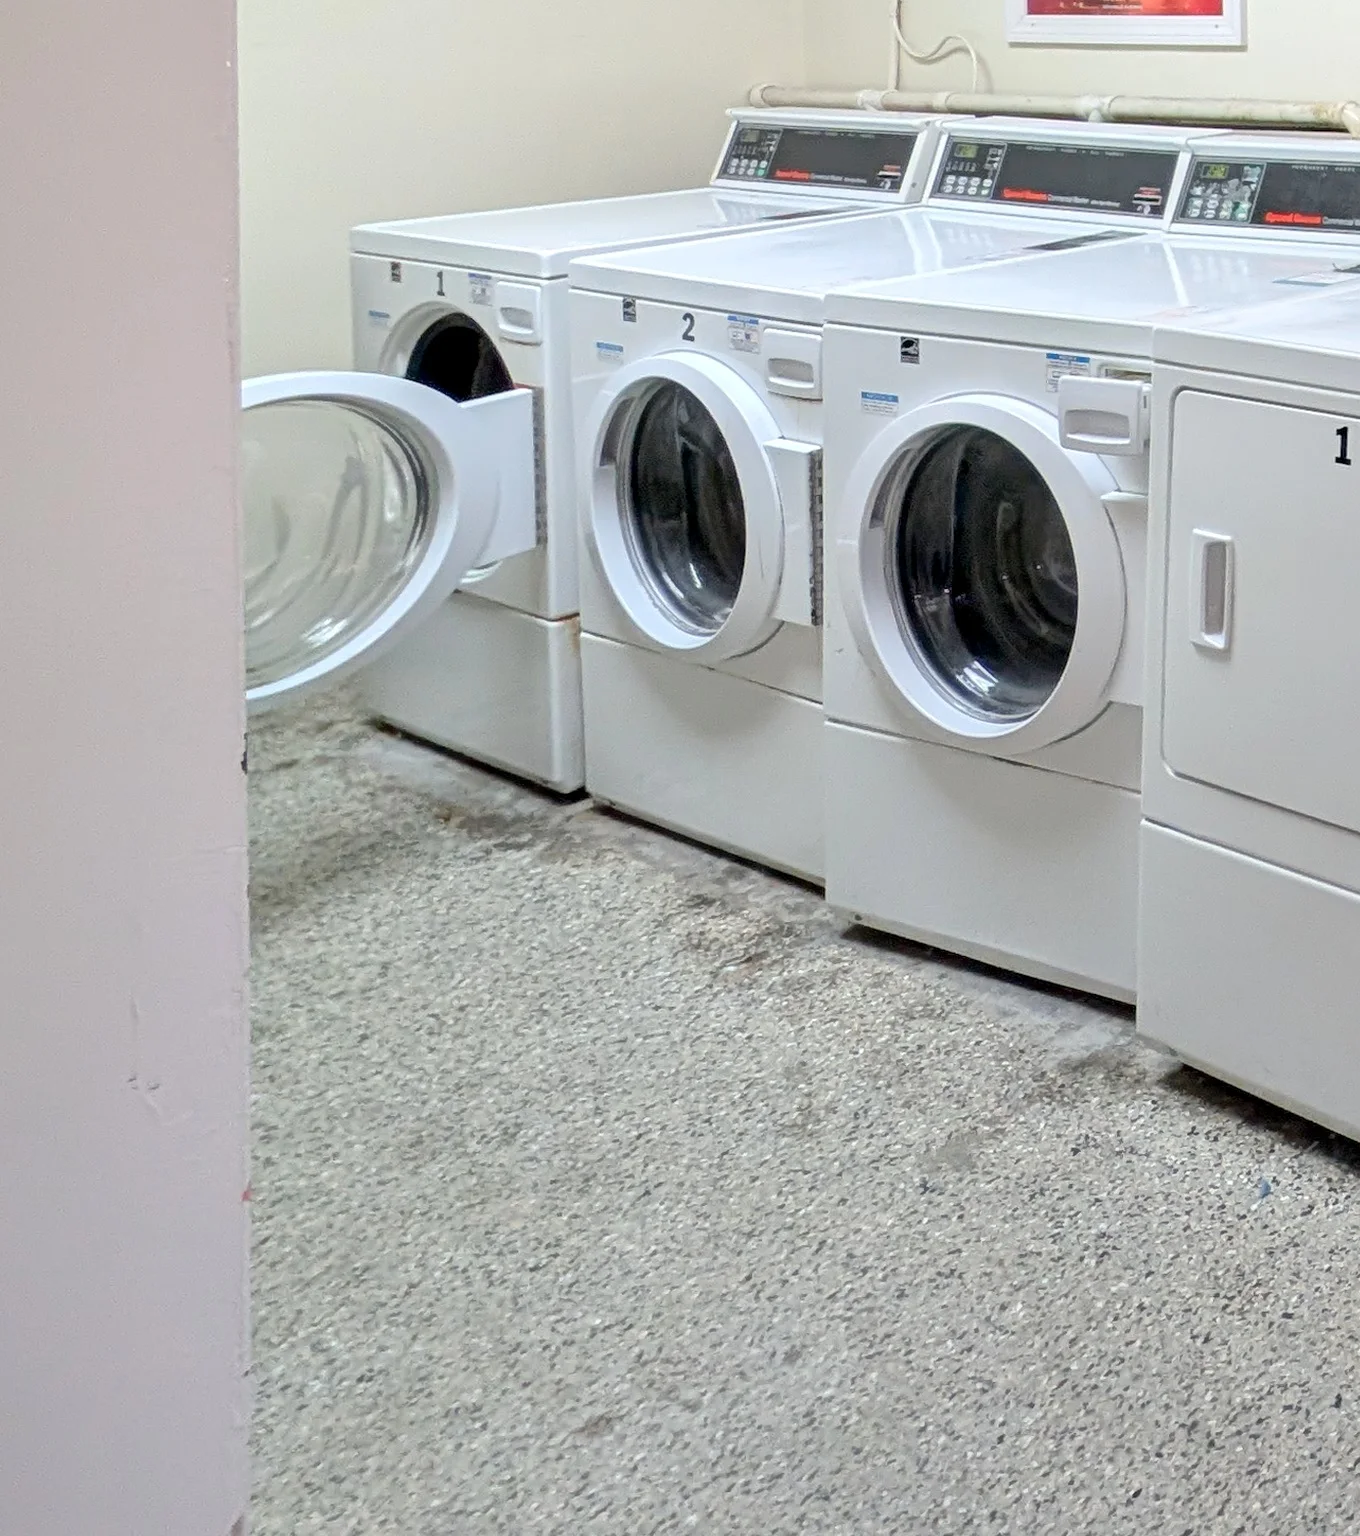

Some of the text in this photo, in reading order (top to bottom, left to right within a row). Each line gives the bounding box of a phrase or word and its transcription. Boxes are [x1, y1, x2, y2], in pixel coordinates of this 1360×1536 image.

[436, 271, 446, 297] 1
[682, 312, 696, 342] 2
[1334, 425, 1352, 466] 1
